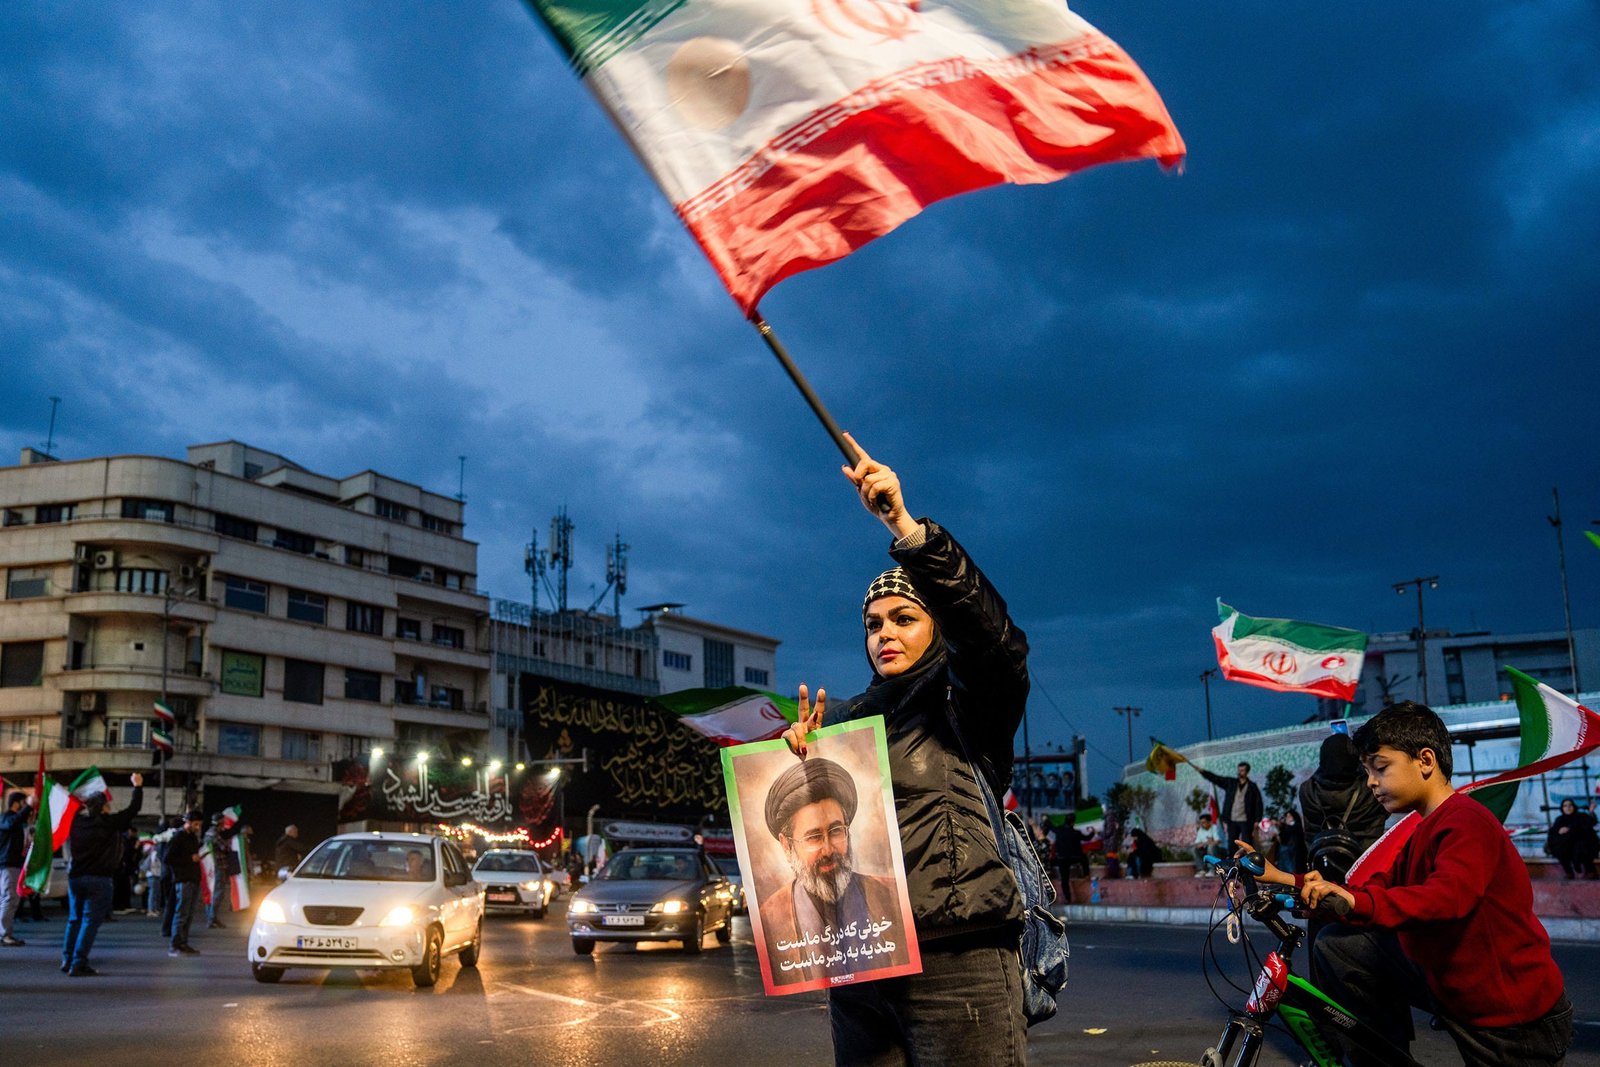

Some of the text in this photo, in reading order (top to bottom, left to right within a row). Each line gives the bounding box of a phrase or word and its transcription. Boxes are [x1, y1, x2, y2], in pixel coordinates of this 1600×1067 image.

[776, 916, 893, 951] خونی که در رگ ماست
[780, 940, 896, 972] هدیه به رهبر ماست
